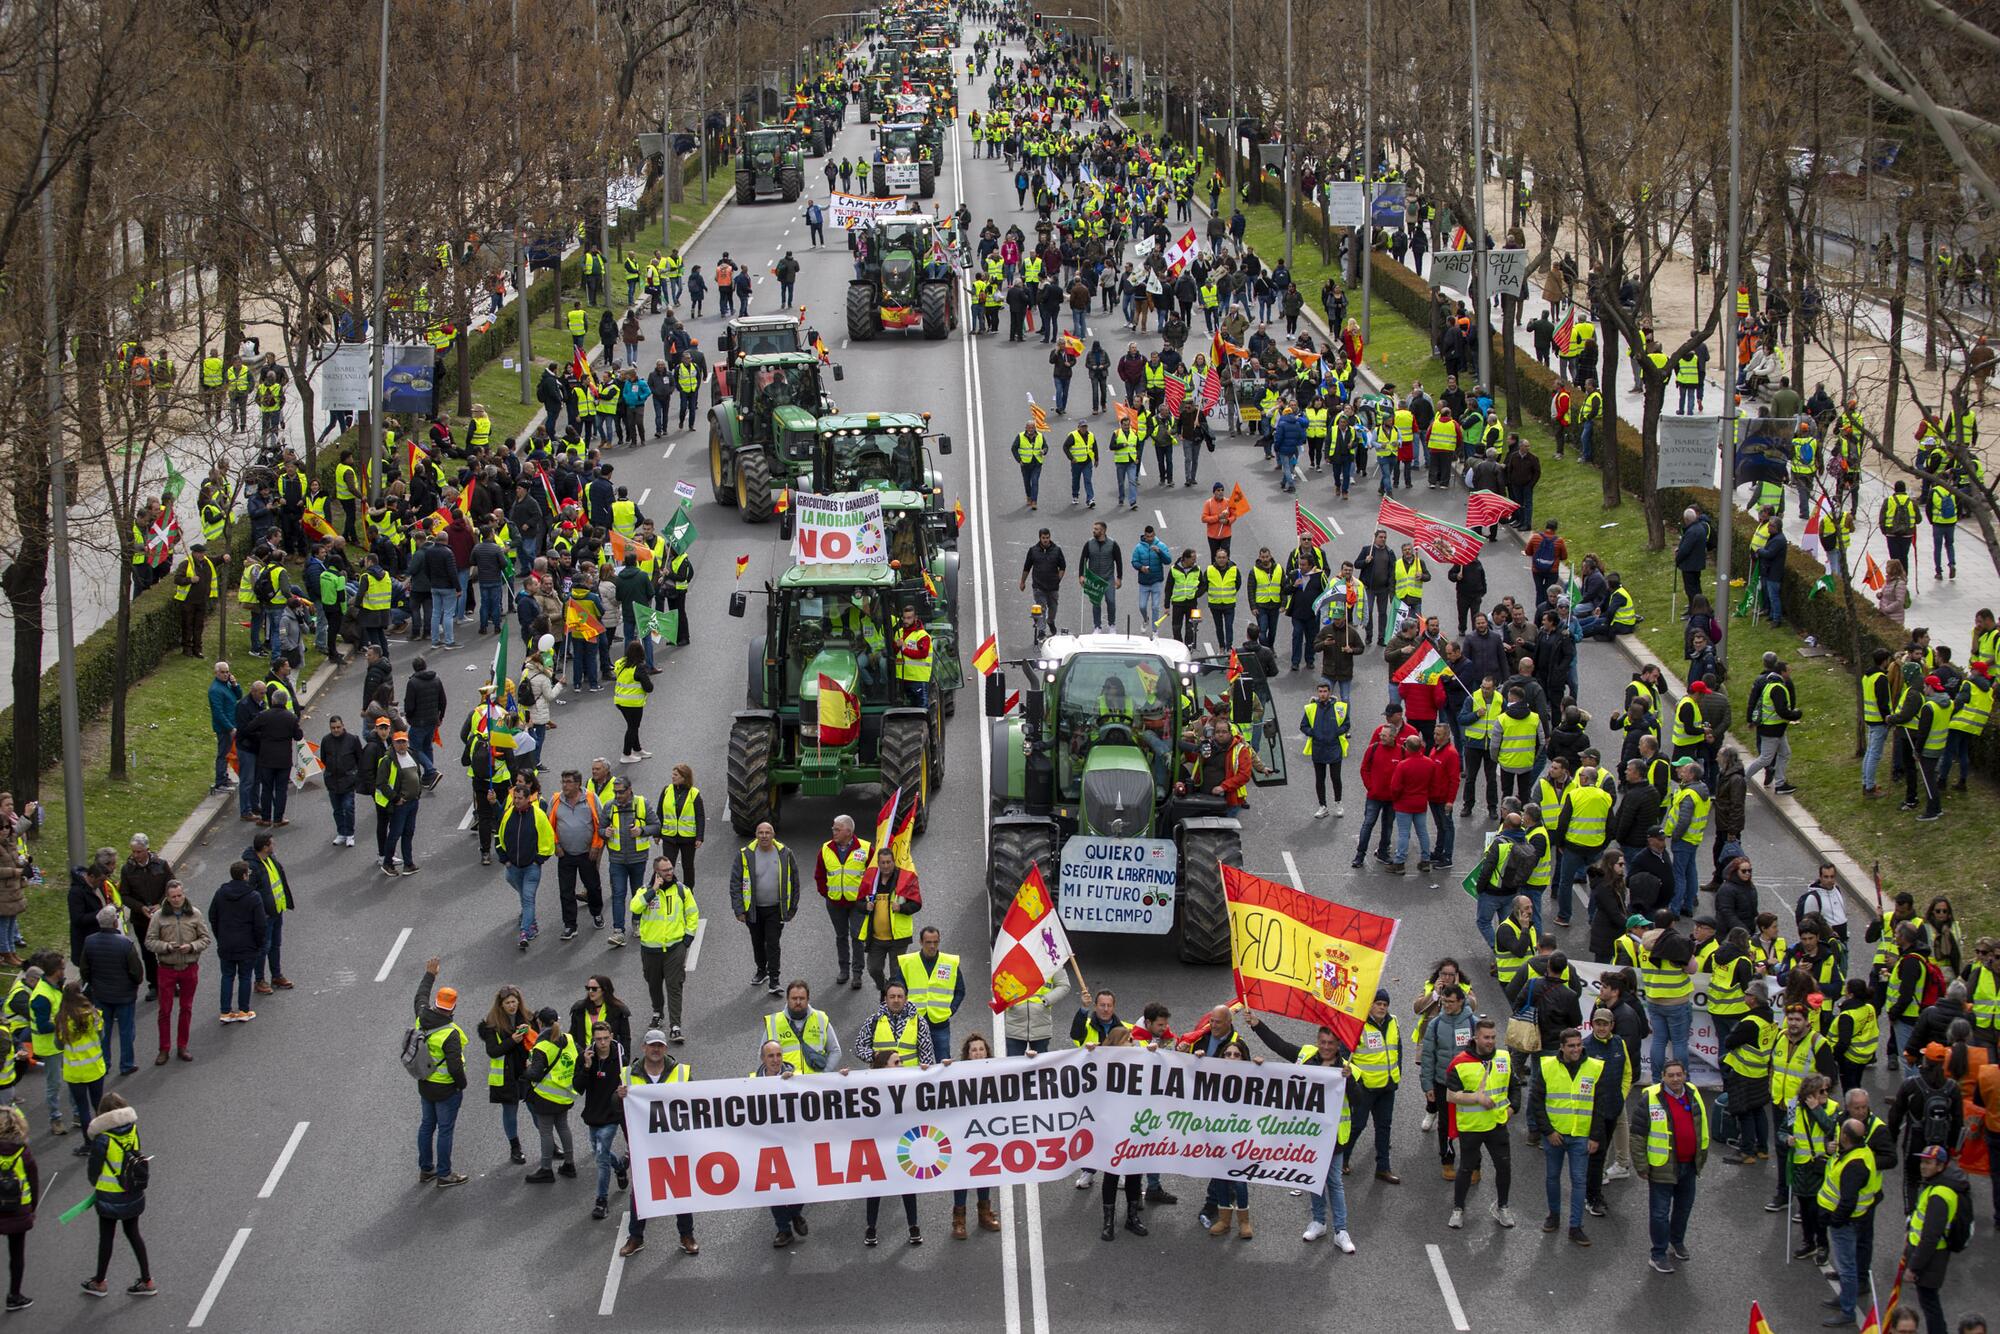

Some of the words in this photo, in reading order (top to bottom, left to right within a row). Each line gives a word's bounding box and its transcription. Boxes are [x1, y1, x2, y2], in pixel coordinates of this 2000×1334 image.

[1434, 254, 1471, 265] MAD
[1446, 262, 1469, 274] RID
[1488, 254, 1519, 264] CUL
[1492, 264, 1512, 276] TU
[1499, 275, 1519, 288] RA
[1662, 446, 1714, 456] QUINTANILLA
[840, 502, 844, 512] Y
[845, 494, 875, 512] GANADEROS
[802, 510, 814, 524] LA
[816, 510, 865, 528] MORAÑA
[799, 528, 852, 560] NO
[1086, 844, 1144, 862] QUIERO
[1062, 864, 1113, 880] SEGUIR
[1117, 867, 1176, 886] LABRANDO
[1064, 882, 1081, 897] MI
[1087, 884, 1140, 902] FUTURO
[1105, 908, 1153, 924] CAMPO
[779, 1030, 792, 1038] NO
[648, 1086, 882, 1134] AGRICULTORES
[888, 1084, 907, 1115] Y
[916, 1062, 1098, 1112] GANADEROS
[1106, 1062, 1144, 1096] DE
[1150, 1064, 1185, 1099] LA
[1192, 1070, 1326, 1114] MORAÑA
[964, 1106, 1096, 1138] AGENDA
[1130, 1108, 1163, 1136] La
[1166, 1110, 1252, 1136] Moraña
[1256, 1114, 1322, 1137] Unida
[966, 1128, 1094, 1176] 2030
[1110, 1136, 1180, 1168] Jamás
[1180, 1141, 1227, 1159] sera
[1231, 1139, 1318, 1164] Vencida
[648, 1151, 740, 1201] NO
[754, 1146, 796, 1192] A
[814, 1138, 887, 1187] LA
[1228, 1160, 1316, 1186] Ávila
